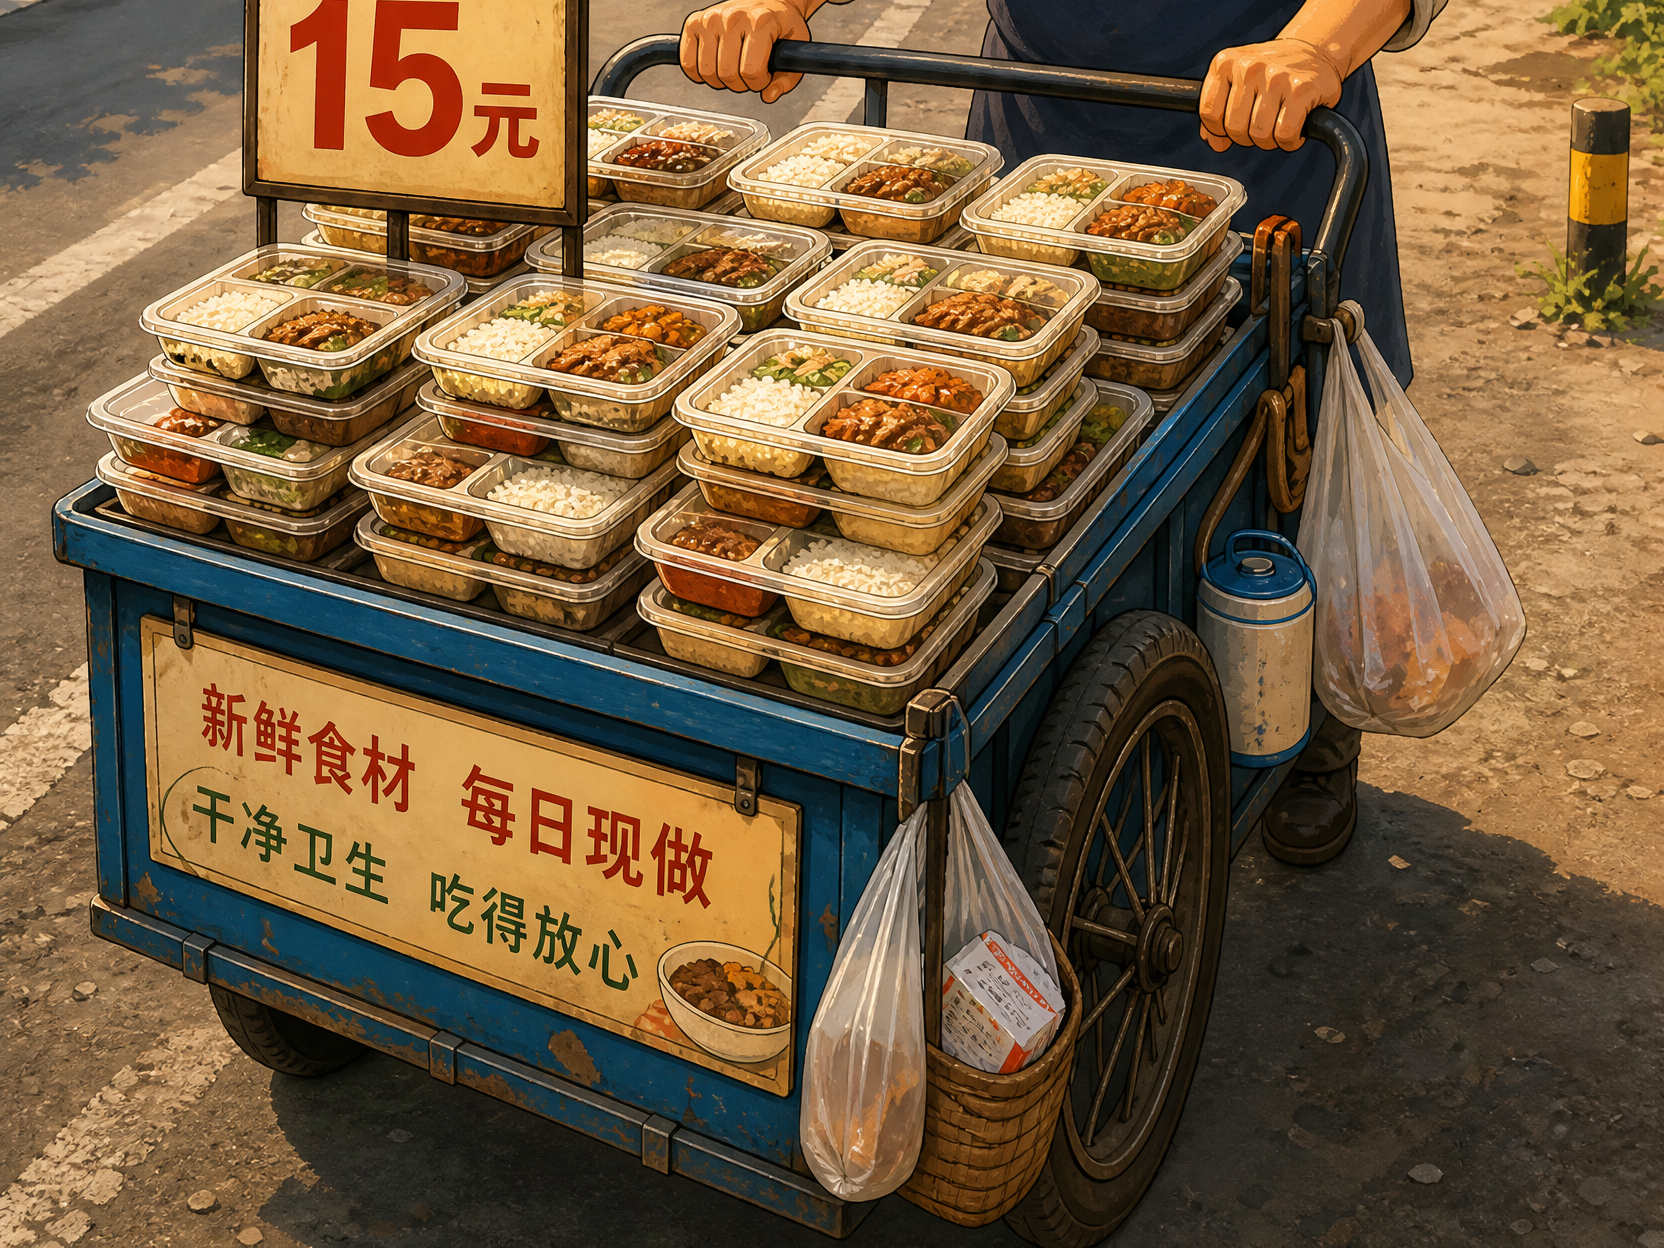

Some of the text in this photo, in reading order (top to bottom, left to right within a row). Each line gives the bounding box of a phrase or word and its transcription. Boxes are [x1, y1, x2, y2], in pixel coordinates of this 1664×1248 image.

[192, 785, 639, 992] 干净卫生 吃得放心
[201, 683, 714, 909] 新鲜食材 每日现做
